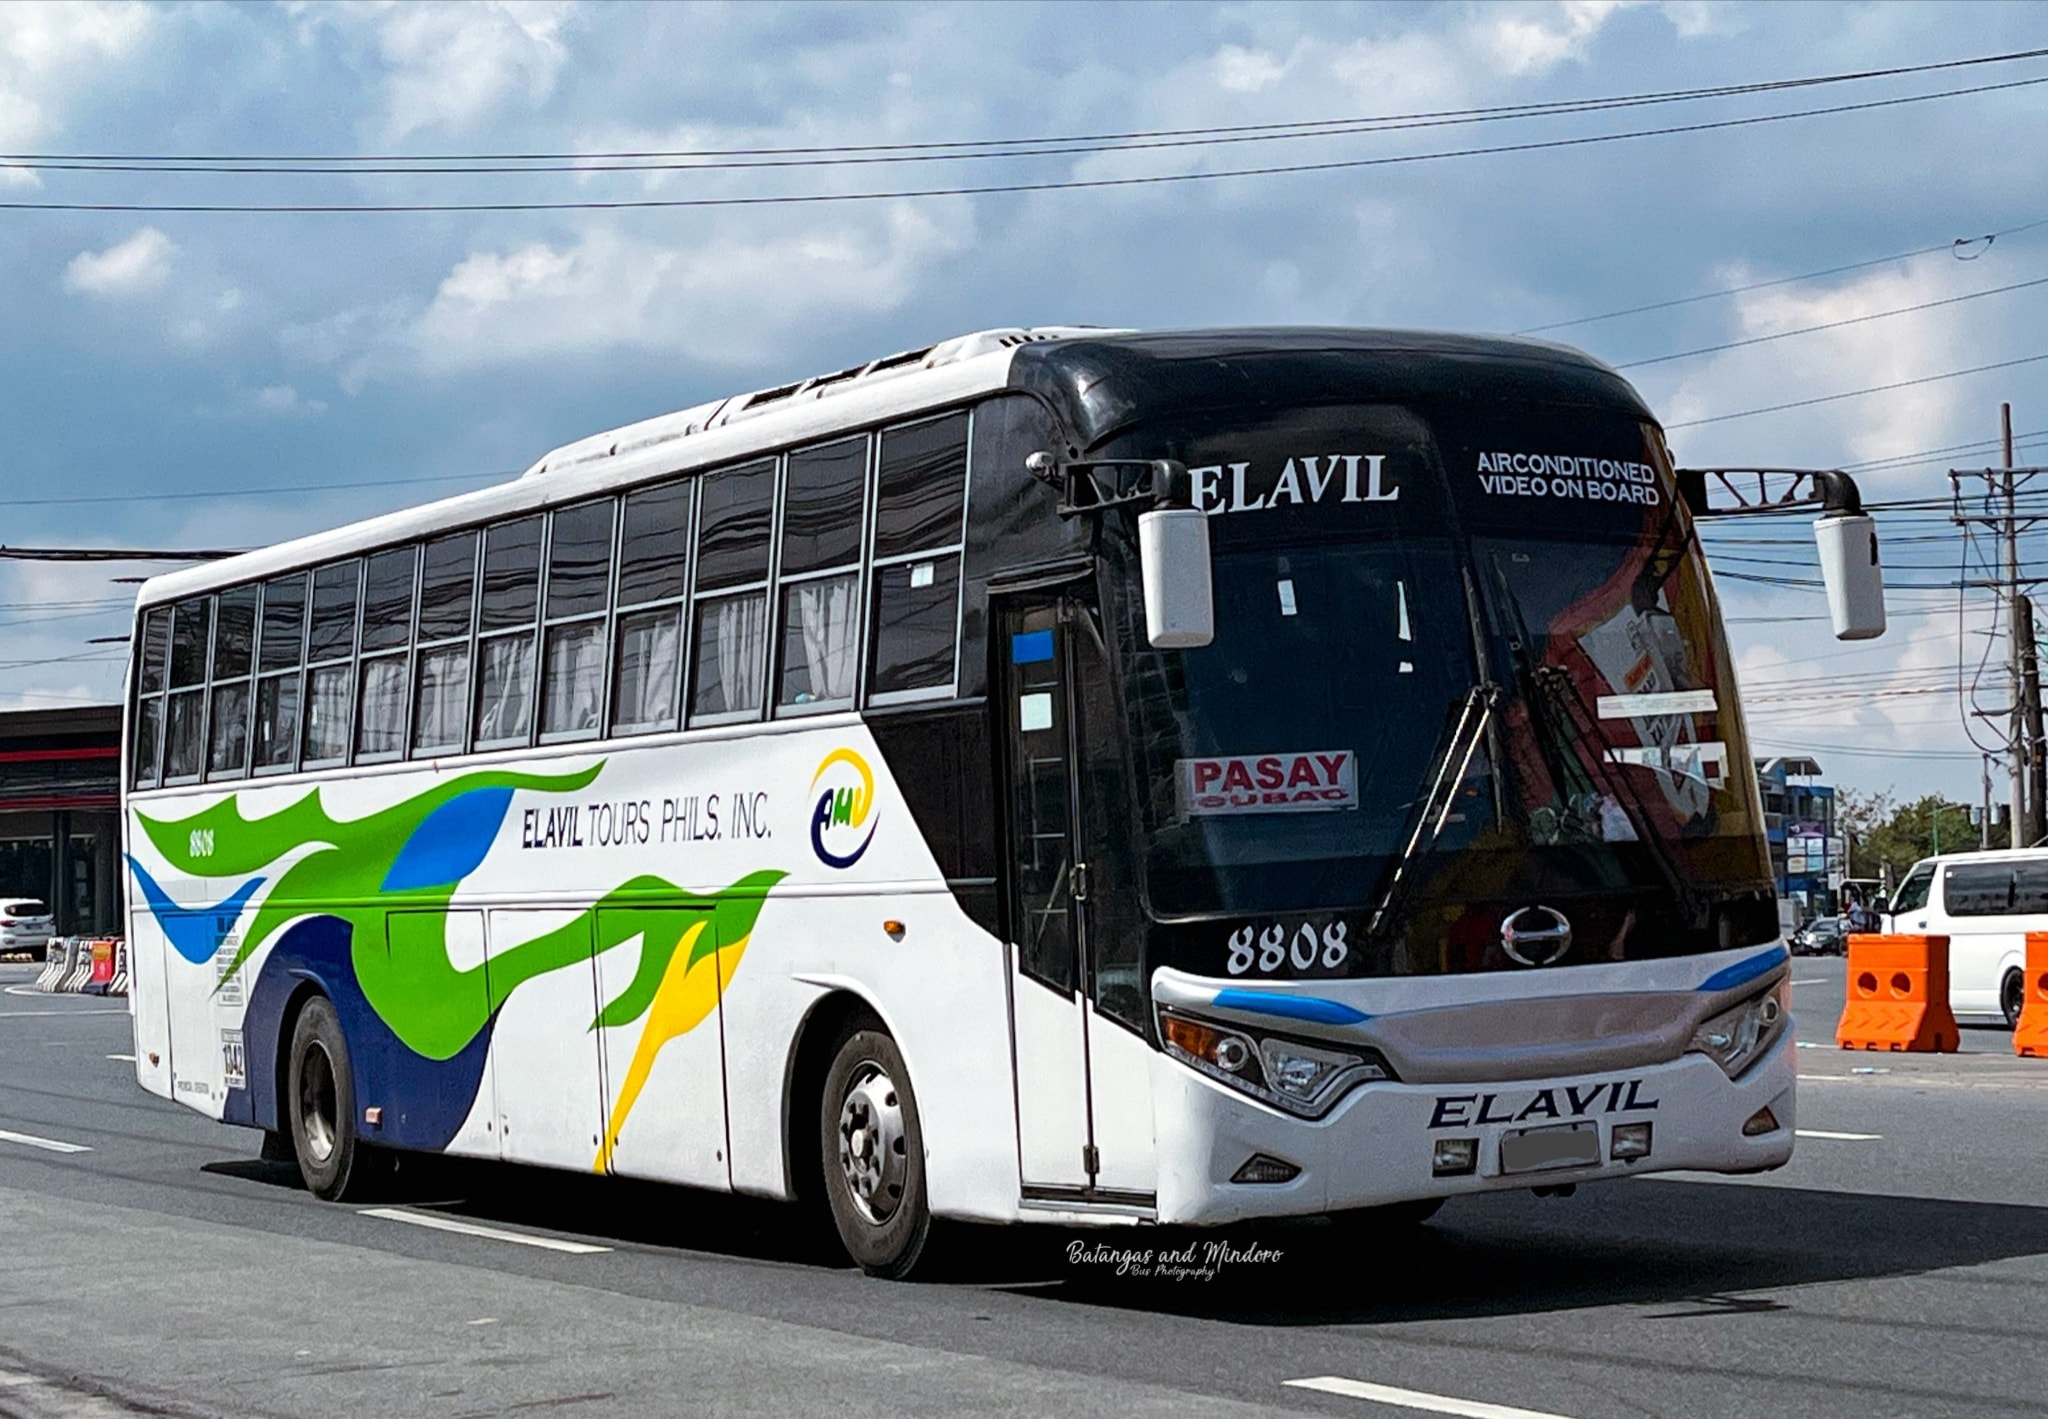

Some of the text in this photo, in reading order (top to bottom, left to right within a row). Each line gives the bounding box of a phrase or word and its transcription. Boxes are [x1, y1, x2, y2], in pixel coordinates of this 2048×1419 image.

[1188, 454, 1400, 516] ELAVIL
[1477, 452, 1655, 485] AIRCONDITIONED
[1478, 474, 1660, 506] VIDEO ON BOARD
[1194, 753, 1348, 794] PASAY
[521, 791, 772, 850] ELAVIL TOURS PHILS. INC.
[1227, 920, 1348, 975] 8808
[1427, 1079, 1660, 1130] ELAVIL
